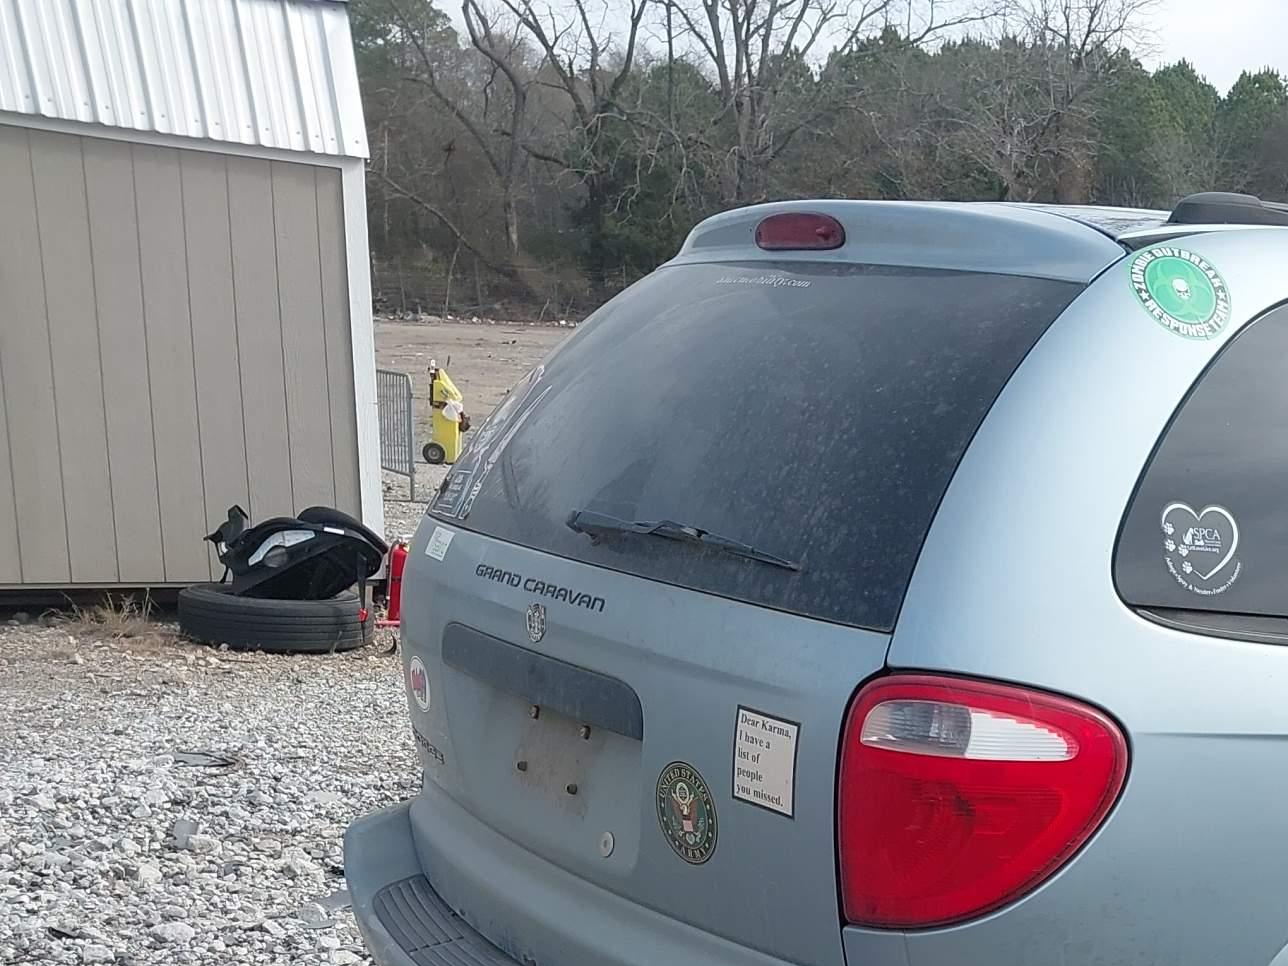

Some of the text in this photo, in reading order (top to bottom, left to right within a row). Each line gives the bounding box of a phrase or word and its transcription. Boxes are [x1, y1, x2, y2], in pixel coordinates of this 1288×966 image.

[1151, 247, 1223, 288] OUTBREAK
[1145, 299, 1214, 337] RESPONSE
[1193, 527, 1221, 541] SPCA
[475, 564, 606, 612] GRAND CARAVAN
[740, 713, 792, 740] Dear Karma,
[739, 730, 771, 749] I have a
[737, 746, 761, 764] list of
[659, 768, 708, 802] UNITED STATES
[736, 767, 763, 782] people
[736, 783, 784, 807] you missed.
[680, 847, 707, 859] ARMY
